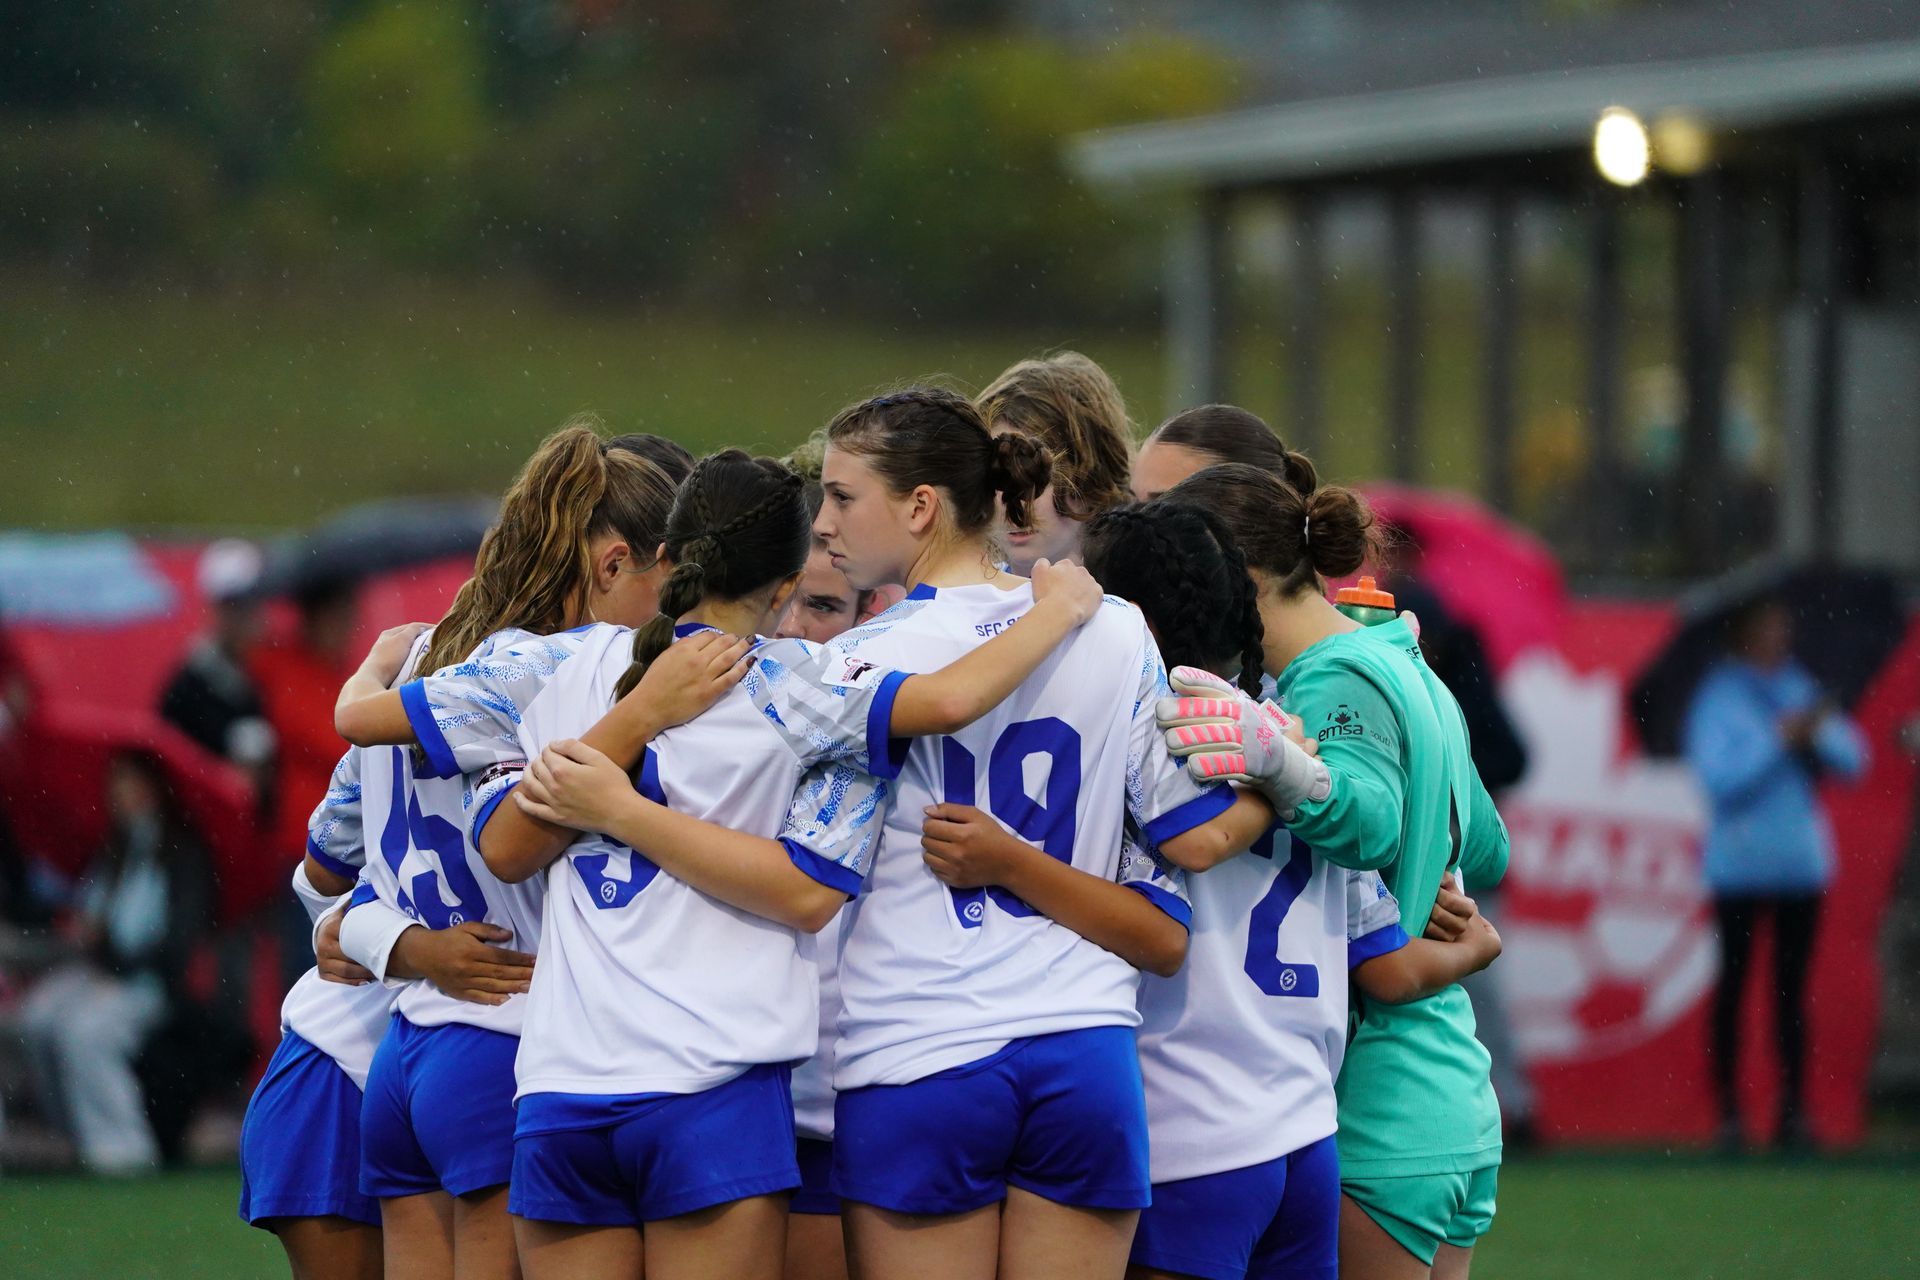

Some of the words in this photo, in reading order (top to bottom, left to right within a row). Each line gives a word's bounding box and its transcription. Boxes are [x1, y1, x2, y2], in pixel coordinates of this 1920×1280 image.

[1318, 724, 1364, 742] emsa
[942, 716, 1082, 929] 19
[1244, 822, 1320, 998] 2
